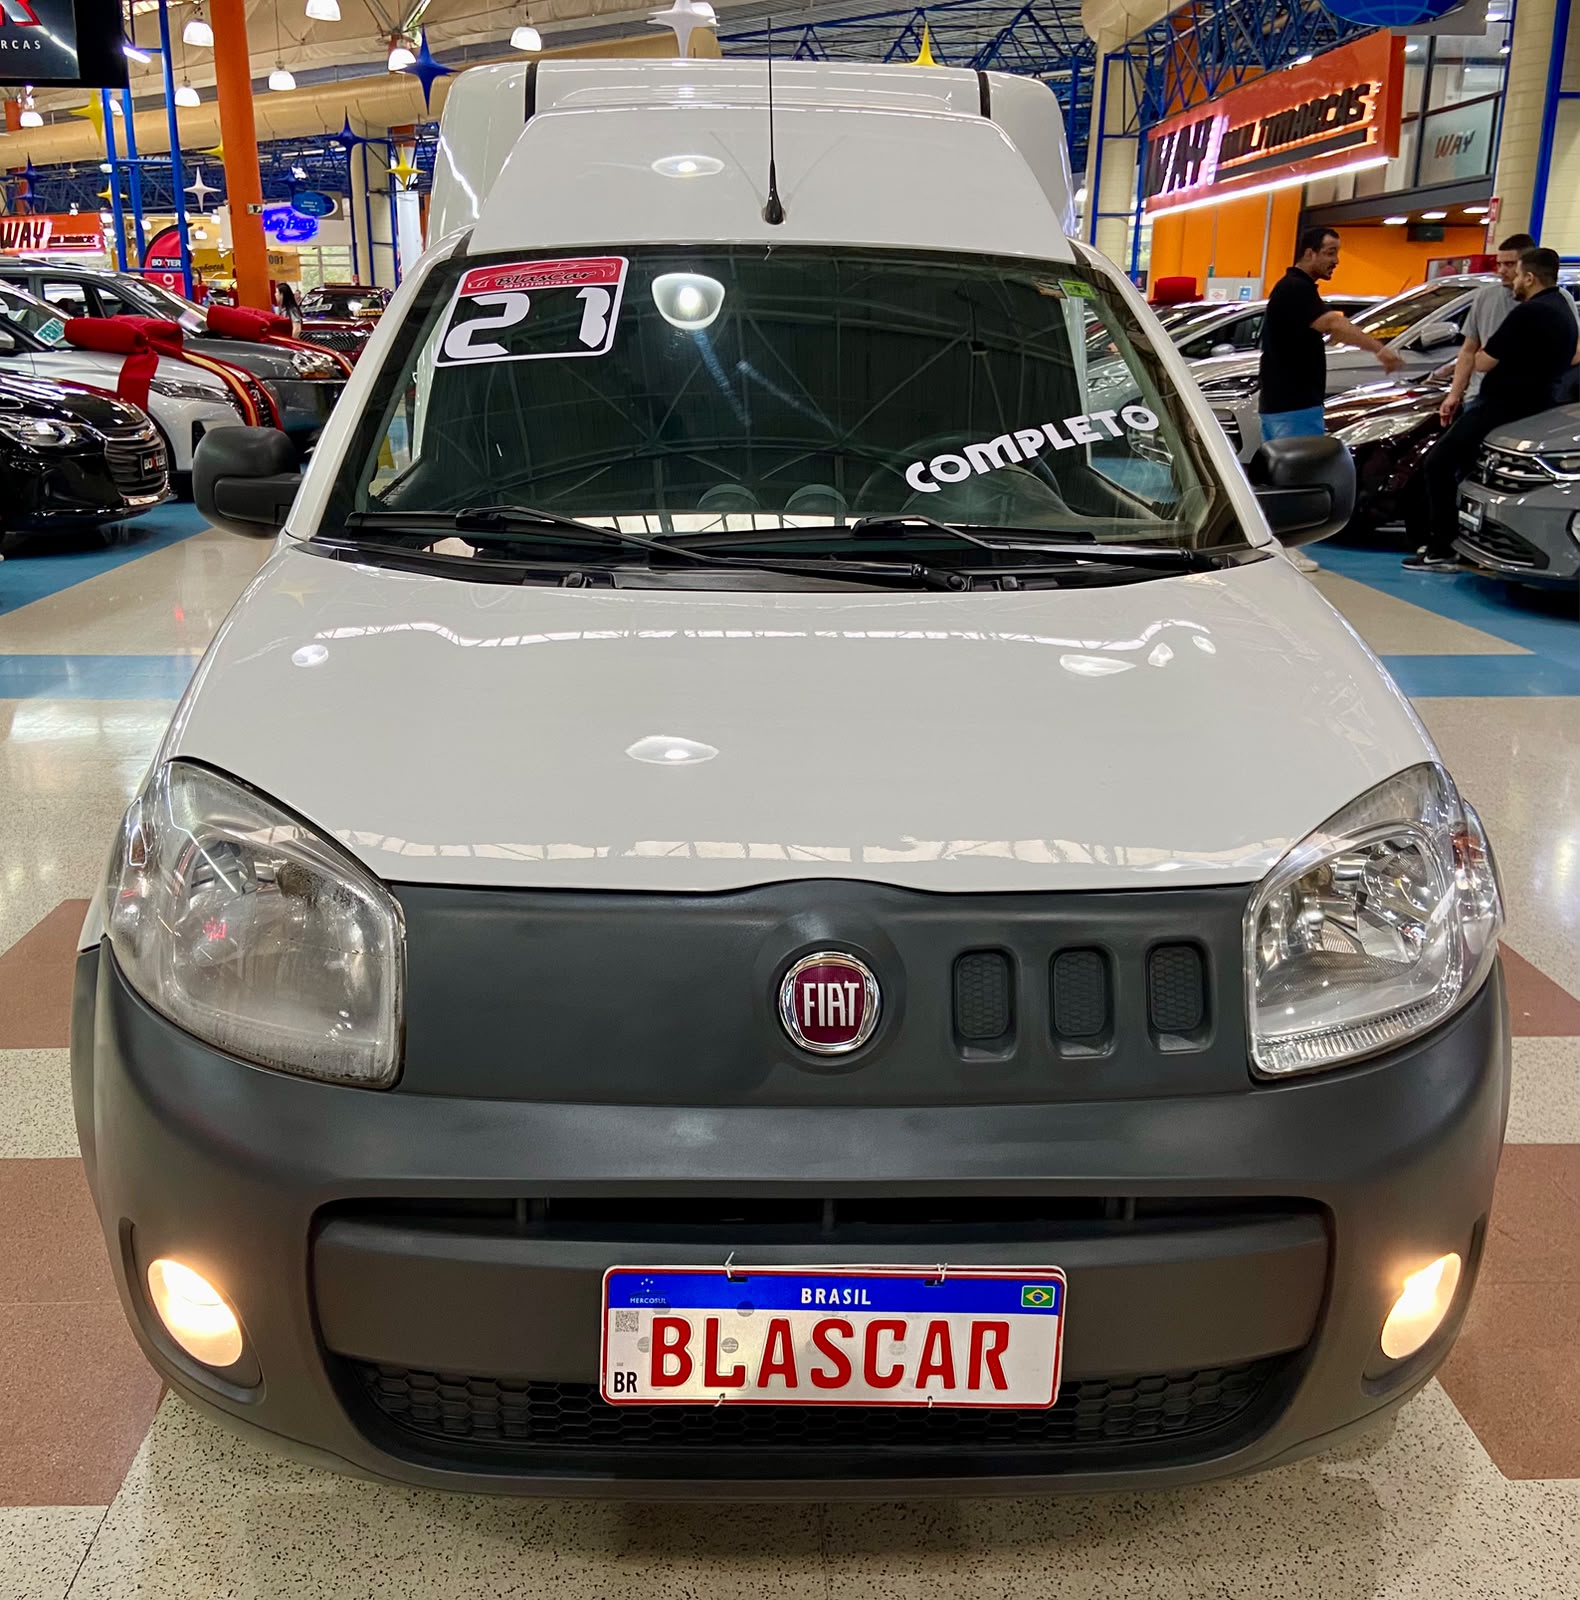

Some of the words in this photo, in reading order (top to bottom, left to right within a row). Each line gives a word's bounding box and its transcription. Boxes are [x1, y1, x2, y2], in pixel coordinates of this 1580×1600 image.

[1434, 130, 1476, 159] WAY
[0, 222, 45, 248] WAY
[444, 286, 611, 360] 21
[905, 404, 1159, 493] COMPLETO
[803, 981, 860, 1027] FIAT
[800, 1287, 872, 1306] BRASIL
[650, 1316, 1011, 1391] BLASCAR
[613, 1371, 638, 1393] BR
